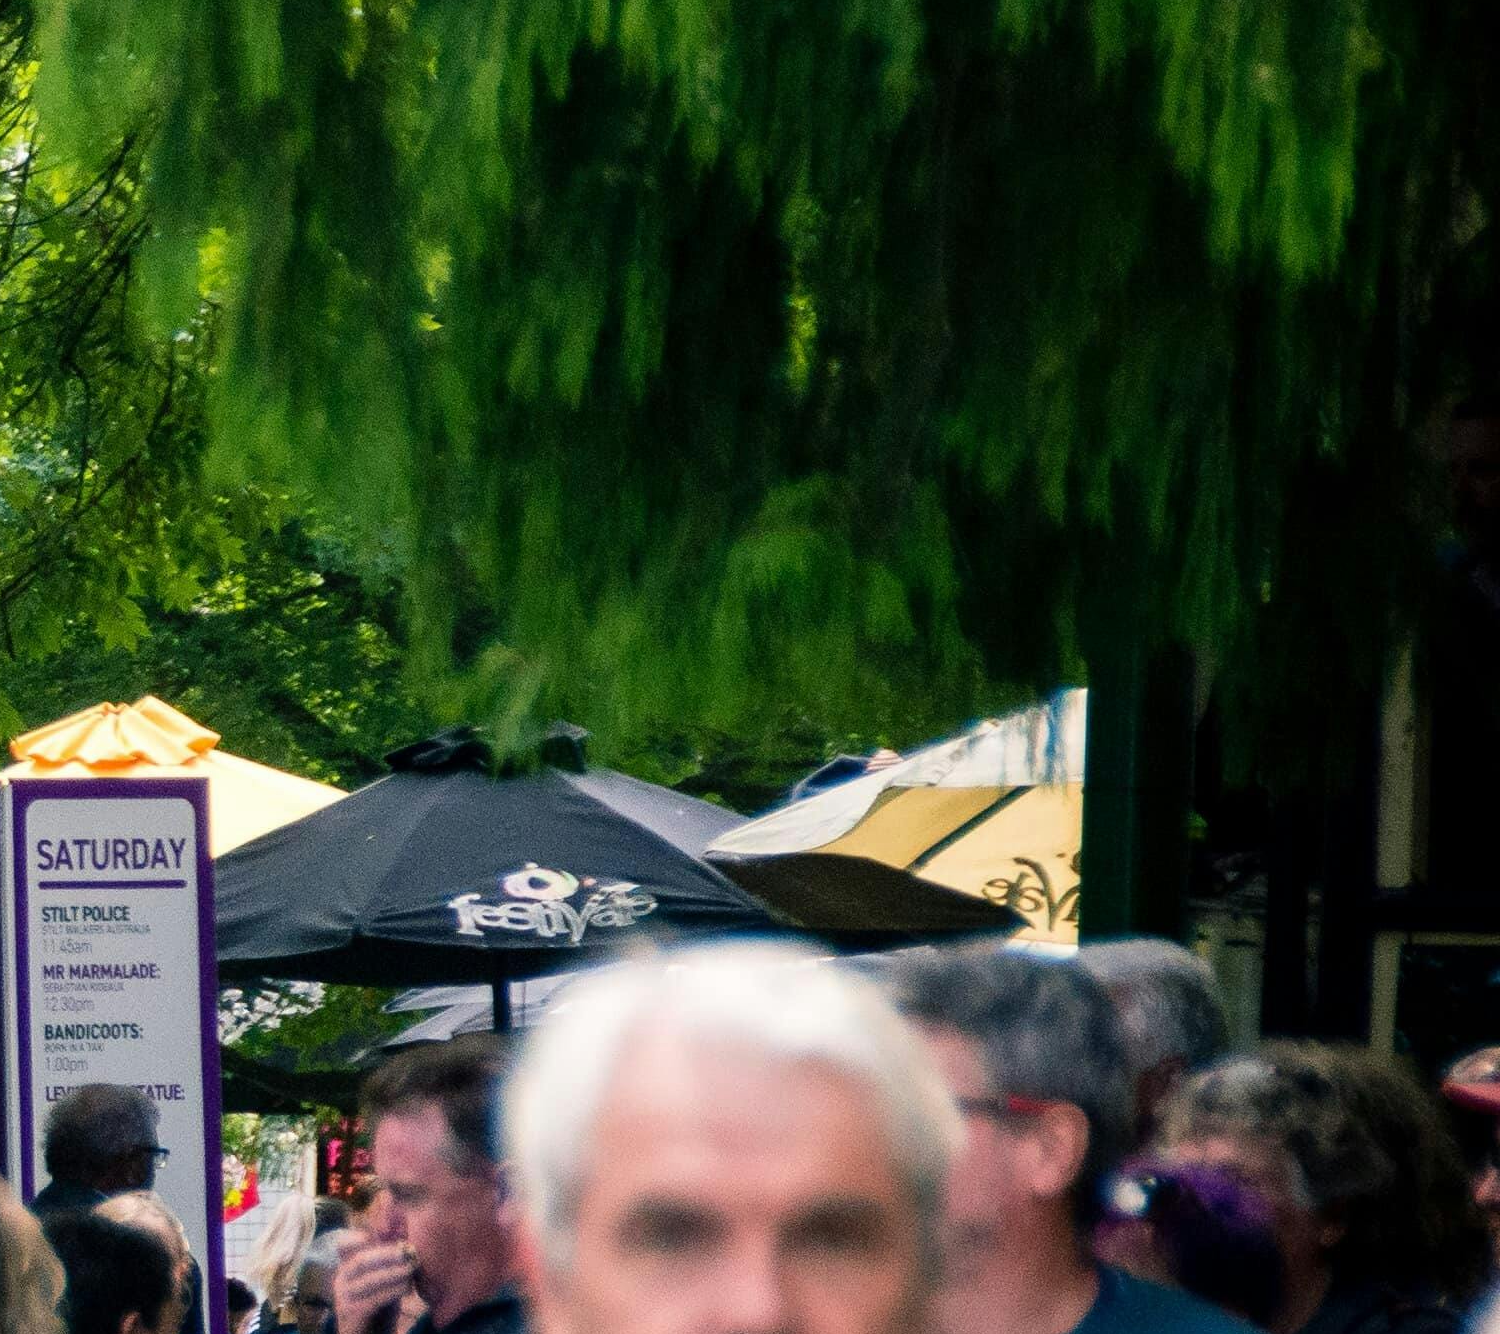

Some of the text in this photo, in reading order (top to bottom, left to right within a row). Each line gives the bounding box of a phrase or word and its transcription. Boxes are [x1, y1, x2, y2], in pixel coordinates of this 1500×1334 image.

[36, 837, 186, 871] SATURDAY
[41, 904, 130, 922] STILT POLICE
[42, 962, 161, 980] MR MARMALADE:
[44, 1023, 144, 1041] BANDICOOTS:
